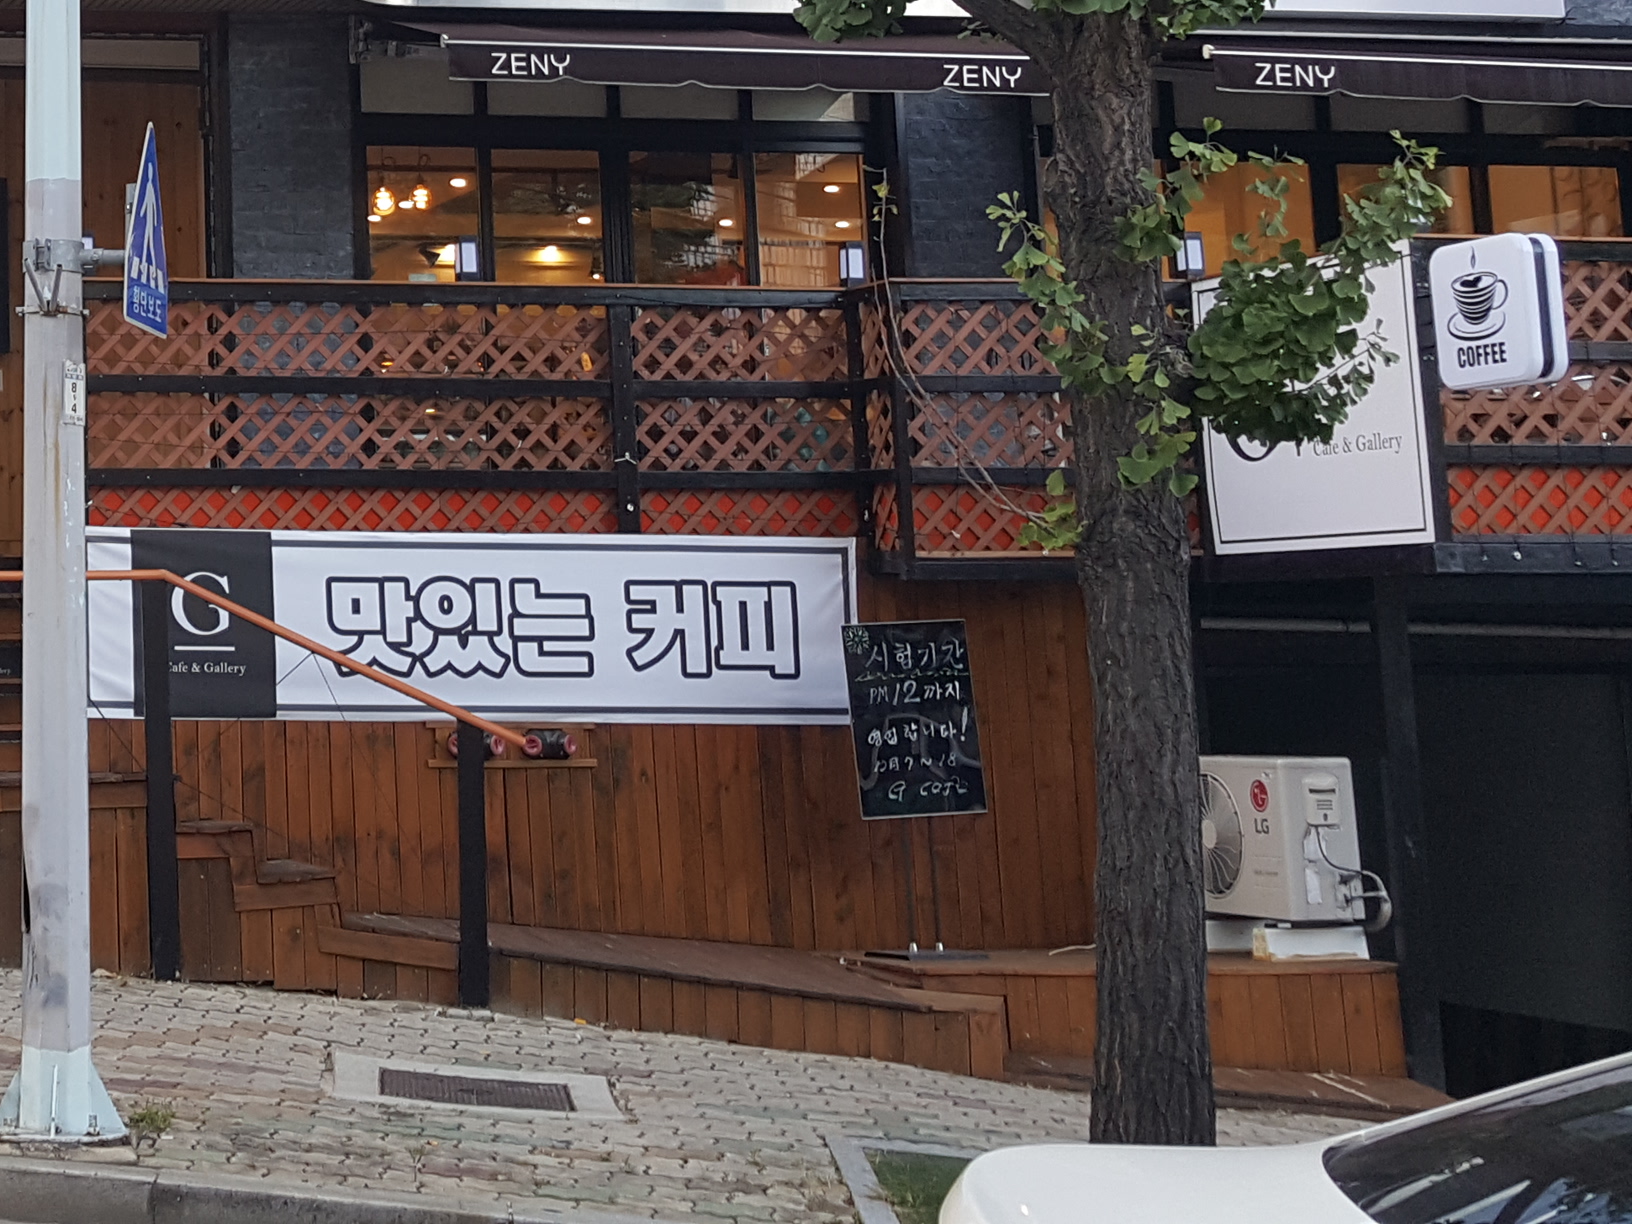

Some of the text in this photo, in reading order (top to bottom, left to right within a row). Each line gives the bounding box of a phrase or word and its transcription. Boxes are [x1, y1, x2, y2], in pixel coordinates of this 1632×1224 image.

[491, 52, 571, 78] ZENY
[943, 64, 1022, 90] ZENY
[1255, 63, 1335, 88] ZENY
[1457, 342, 1507, 369] COFFEE
[1342, 437, 1352, 453] &
[1356, 432, 1402, 454] Gallery
[171, 571, 230, 636] G
[326, 576, 801, 680] 맛있는 커피
[865, 638, 965, 672] 시험기간
[169, 661, 246, 677] afe & Gallery
[1254, 818, 1269, 834] LG
